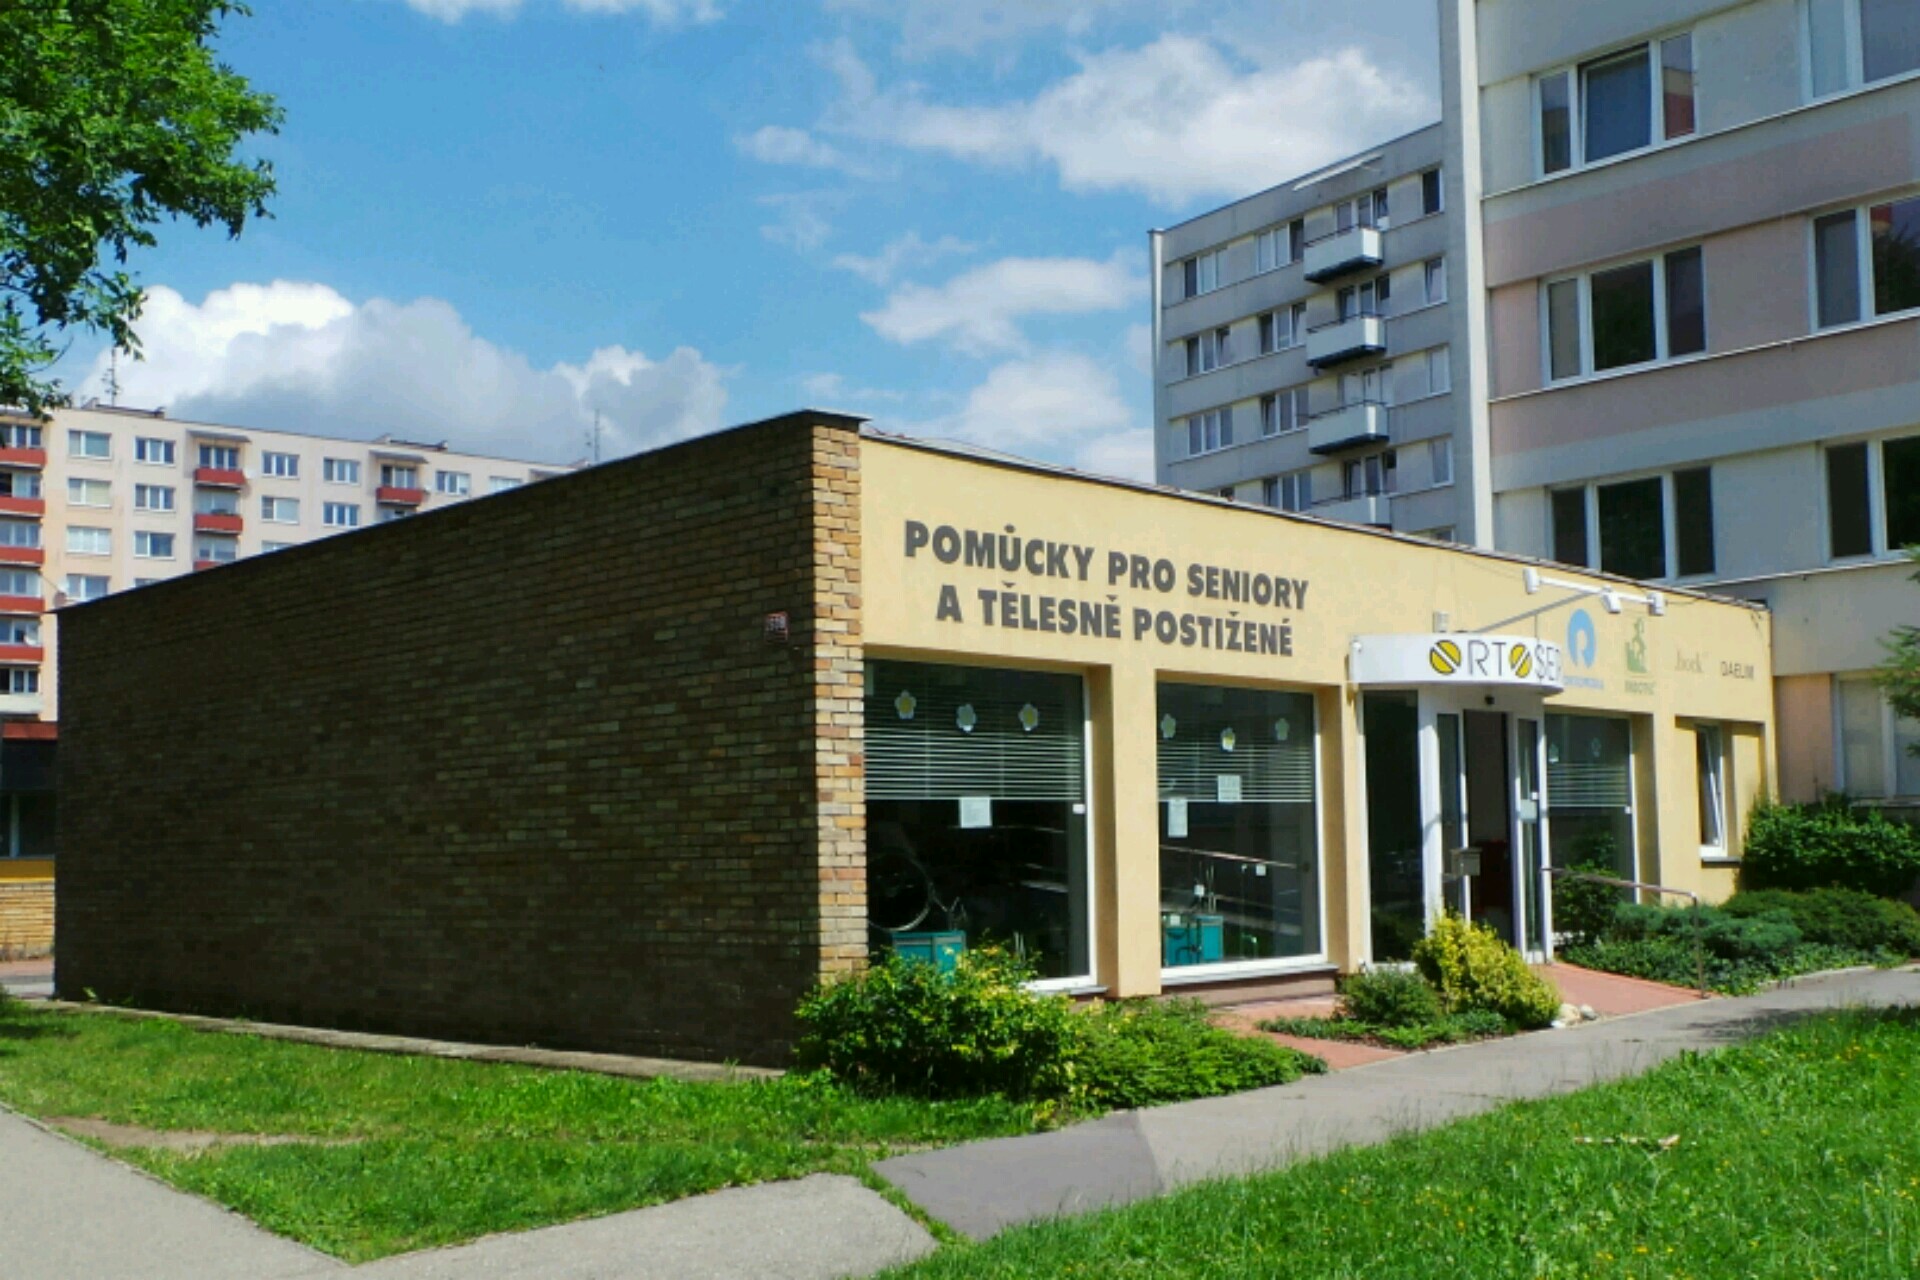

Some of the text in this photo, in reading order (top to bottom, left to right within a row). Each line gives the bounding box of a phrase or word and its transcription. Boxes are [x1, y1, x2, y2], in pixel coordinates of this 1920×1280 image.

[904, 519, 1309, 610] POMŮCKY PRO SENIORY
[935, 582, 1293, 657] A TĚLESNĚ POSTIŽENÉ
